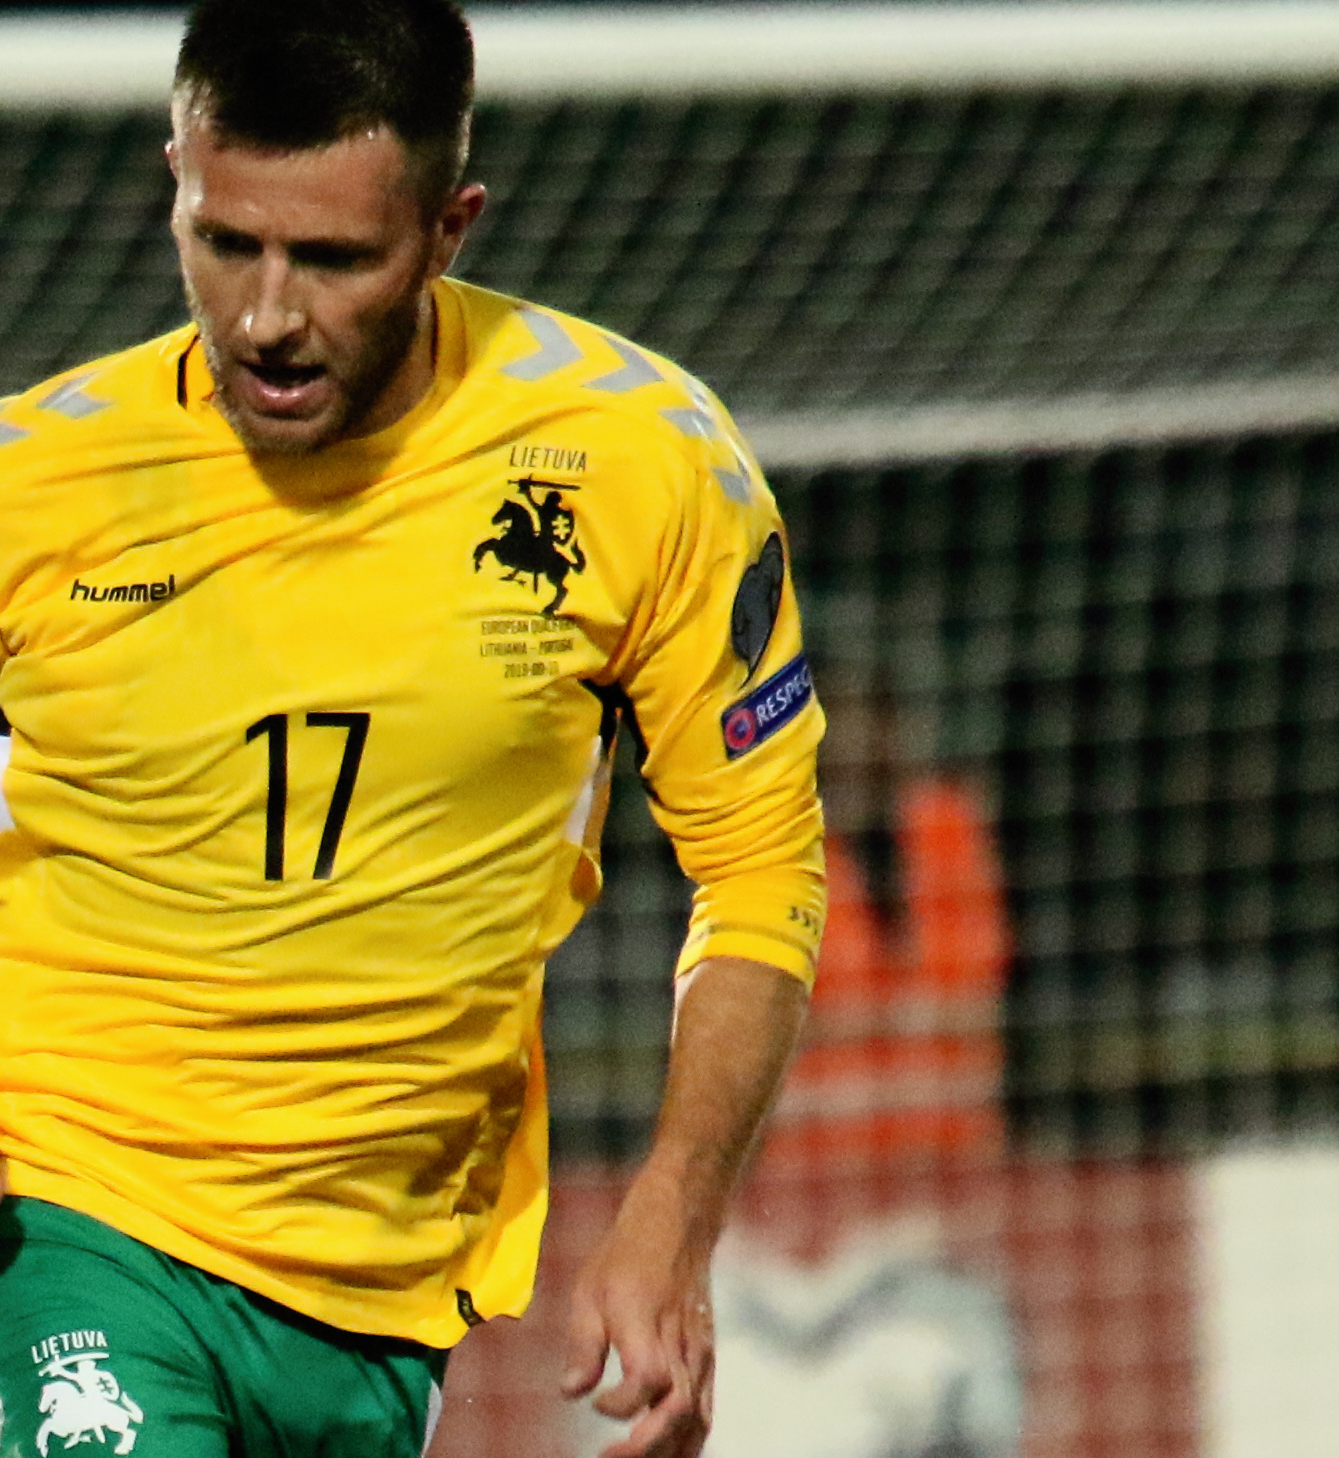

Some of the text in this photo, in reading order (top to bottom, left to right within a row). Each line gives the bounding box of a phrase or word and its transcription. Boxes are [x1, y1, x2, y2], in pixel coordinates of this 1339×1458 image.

[508, 444, 588, 473] LIETUVA
[69, 573, 176, 602] hummel
[245, 712, 372, 881] 17
[30, 1329, 109, 1364] LIETUVA
